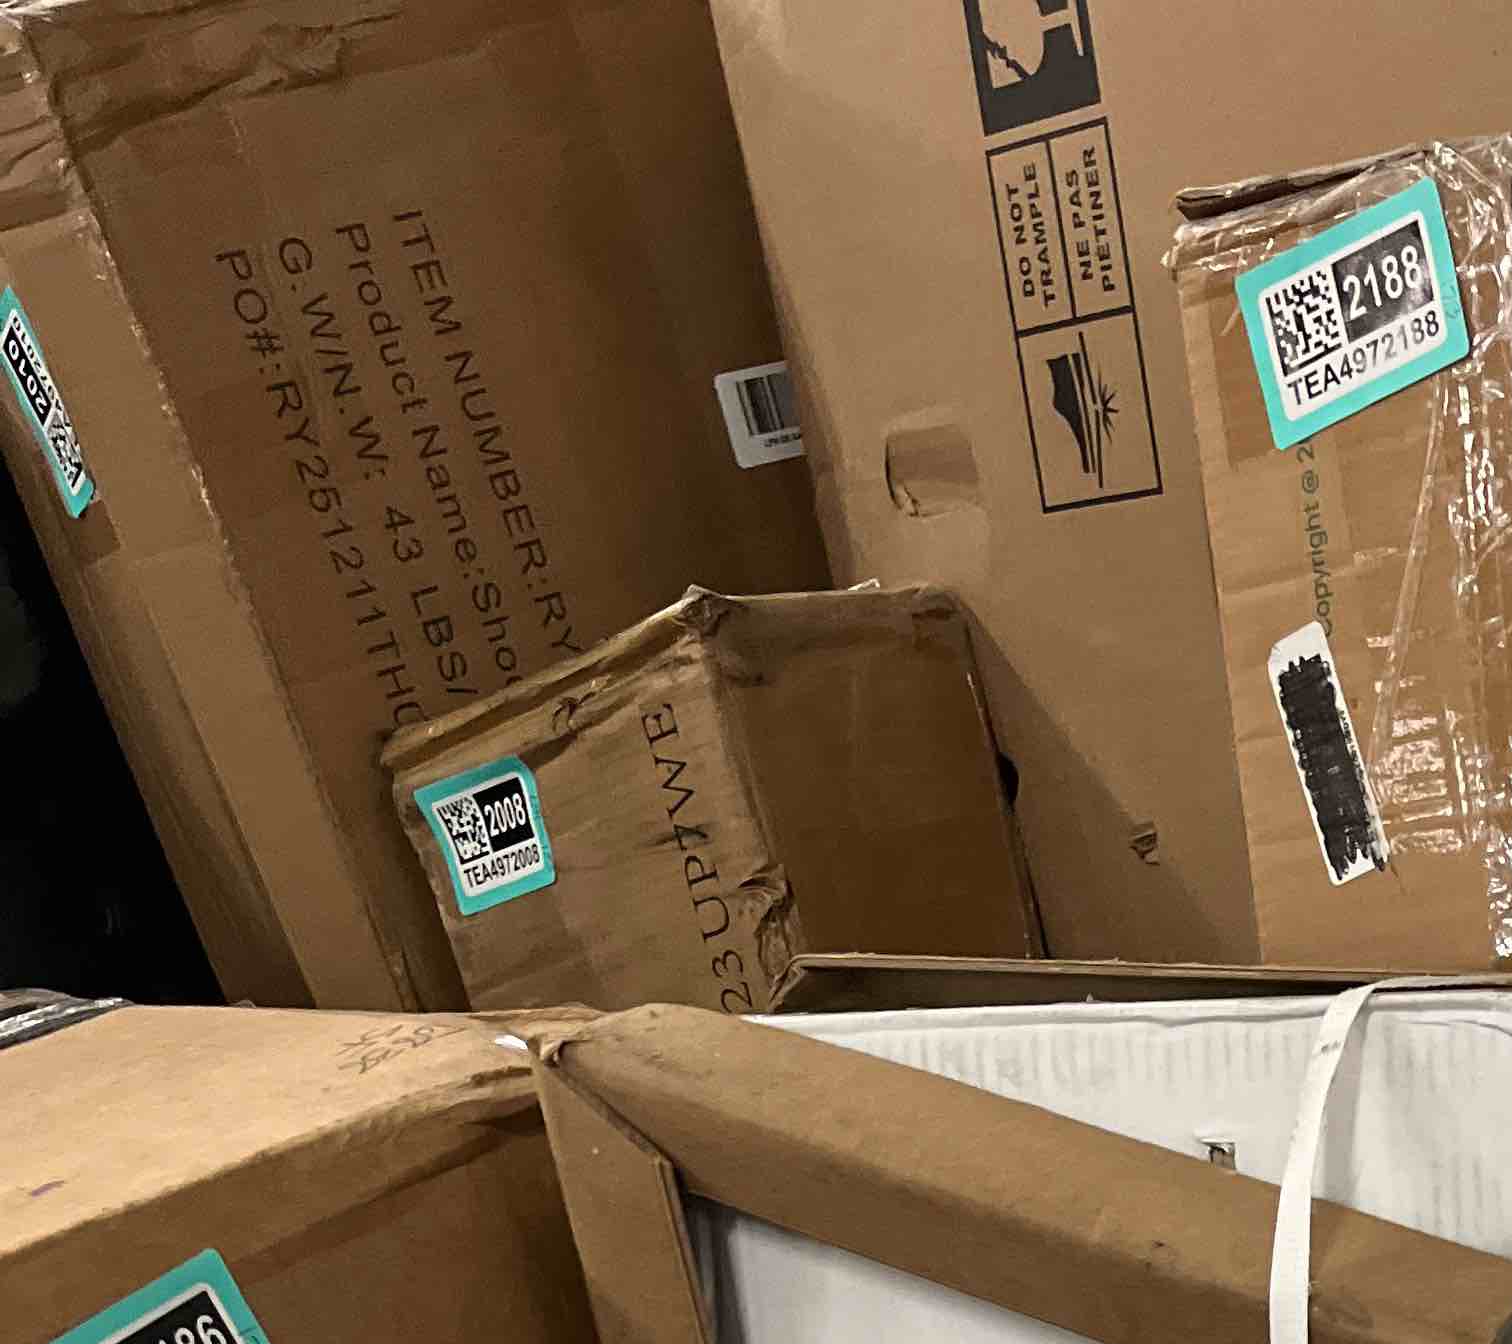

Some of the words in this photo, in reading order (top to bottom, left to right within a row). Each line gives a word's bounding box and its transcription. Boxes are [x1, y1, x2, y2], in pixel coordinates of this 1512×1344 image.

[1005, 183, 1027, 245] NOT
[1065, 169, 1087, 229] PAS
[1083, 145, 1116, 293] PIETINER
[1023, 161, 1056, 308] TRAMPLE
[1076, 239, 1094, 281] NE
[393, 209, 462, 336] ITEM
[1018, 256, 1036, 298] DO
[1342, 245, 1424, 322] 2188
[335, 222, 427, 415] Product
[8, 339, 49, 416] 2010
[1287, 309, 1441, 406] TEA4972188
[384, 505, 424, 564] 43
[483, 793, 527, 838] 2008
[463, 843, 541, 891] TEA4972008
